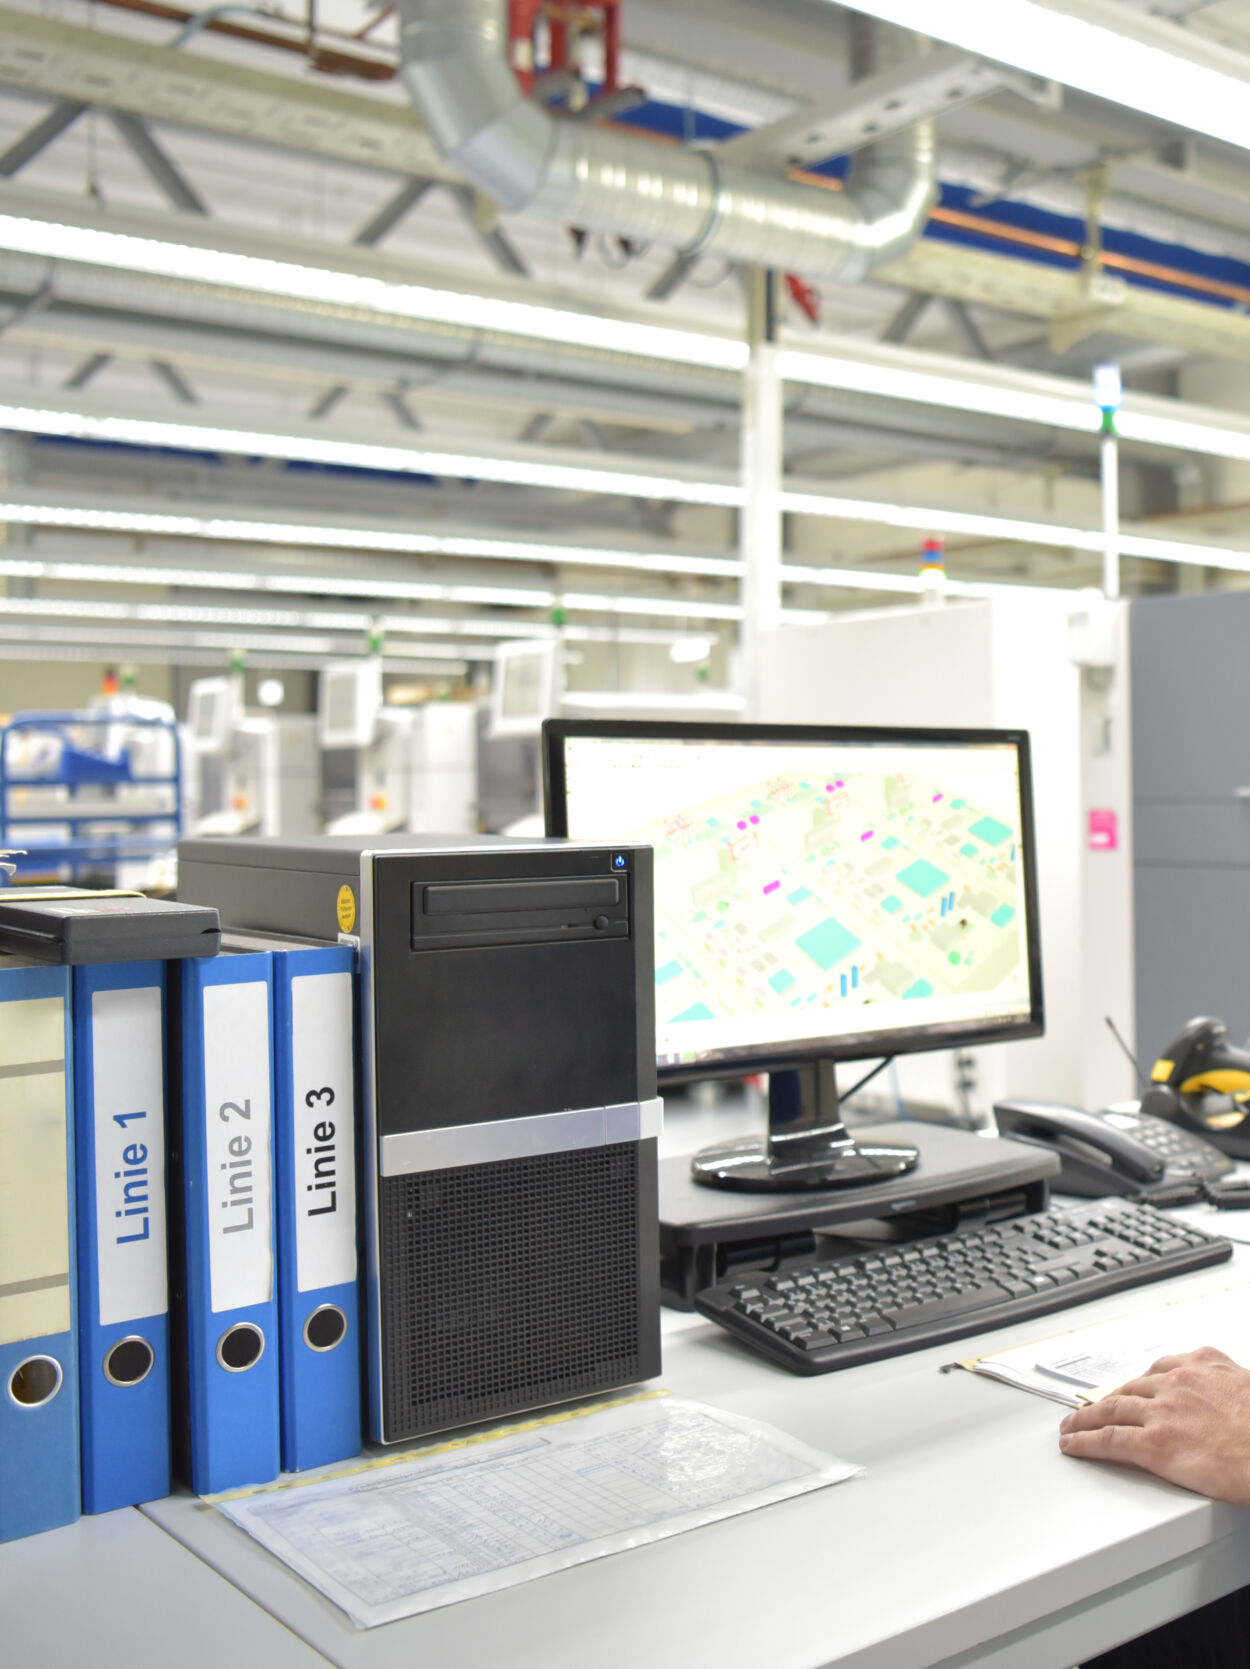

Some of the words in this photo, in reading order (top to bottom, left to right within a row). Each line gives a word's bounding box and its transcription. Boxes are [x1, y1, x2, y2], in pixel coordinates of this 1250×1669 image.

[112, 1111, 147, 1129] 1
[219, 1098, 251, 1123] 2
[305, 1086, 336, 1109] 3
[114, 1143, 149, 1244] Linie
[220, 1135, 254, 1234] Linie
[306, 1120, 337, 1217] Linie
